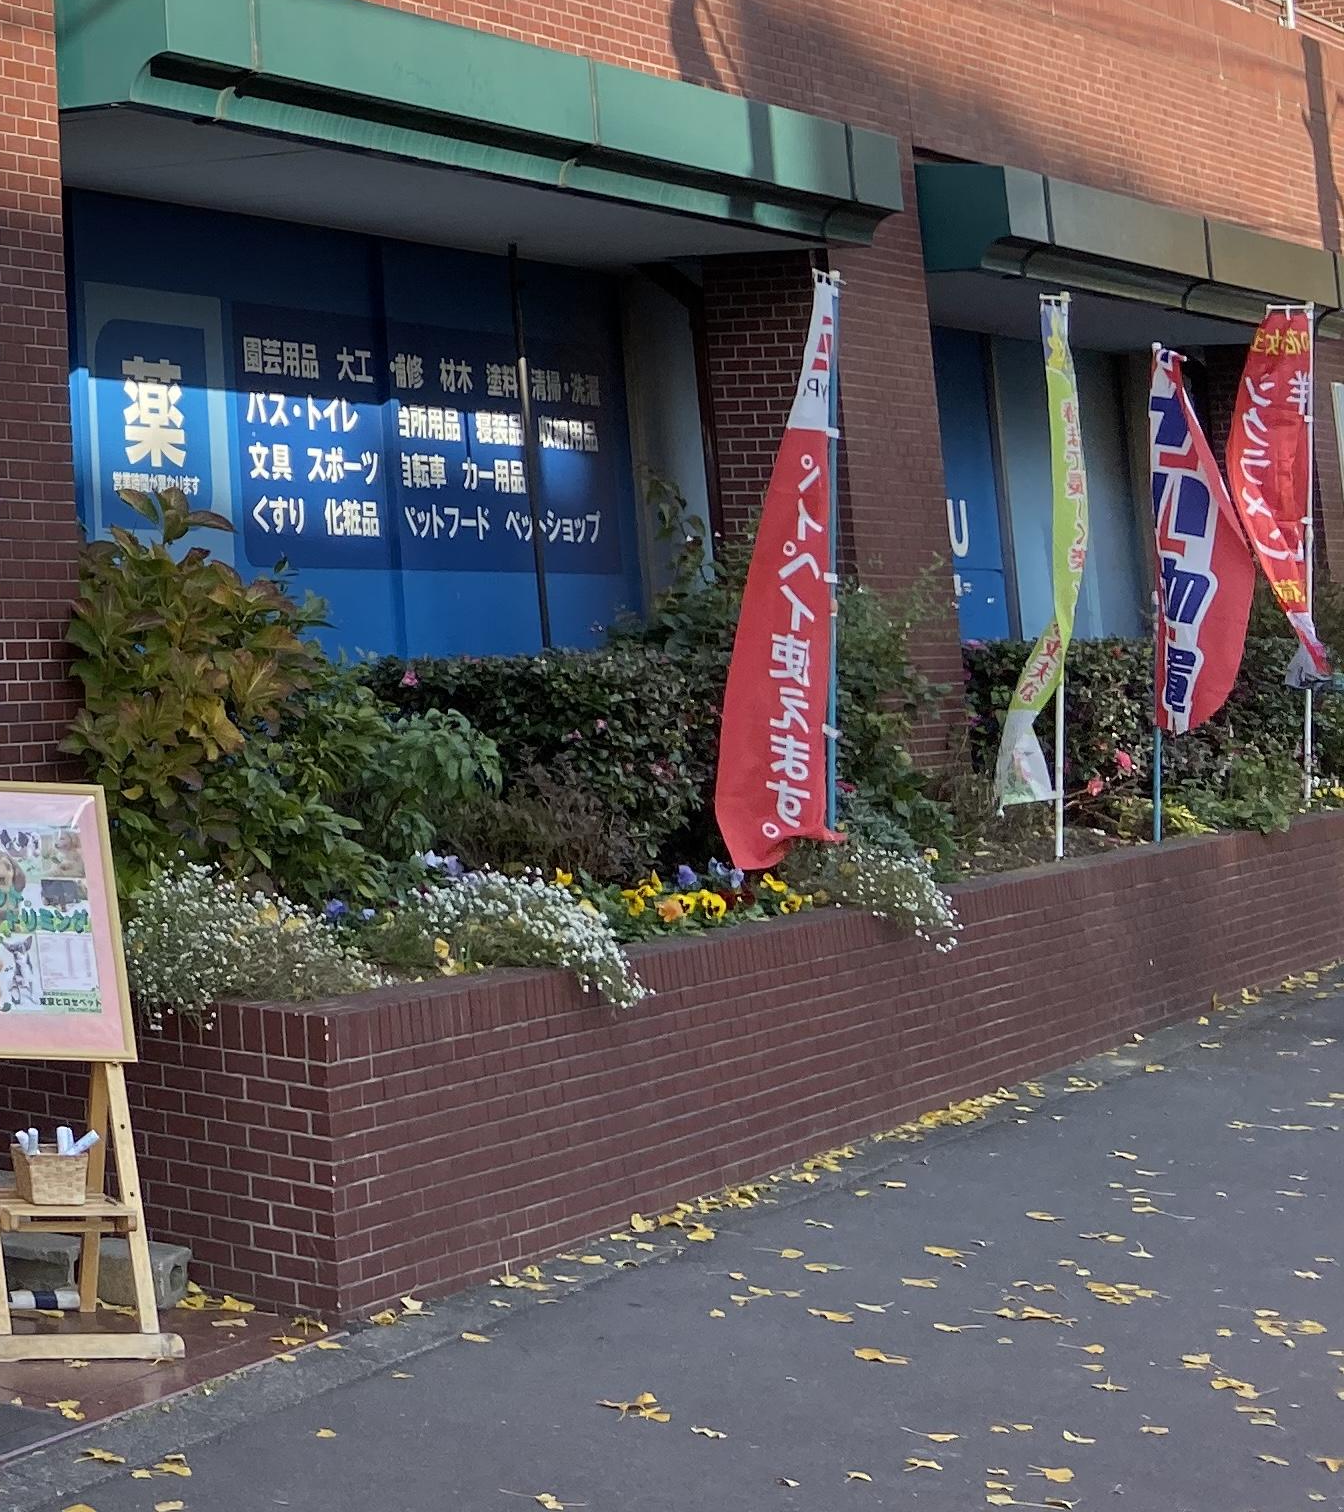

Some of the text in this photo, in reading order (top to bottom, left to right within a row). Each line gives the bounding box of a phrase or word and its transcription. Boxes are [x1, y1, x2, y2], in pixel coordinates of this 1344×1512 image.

[242, 336, 319, 380] 園芸用品
[439, 357, 473, 394] 材木
[486, 362, 519, 399] 塗料
[121, 355, 187, 468] 薬
[246, 391, 359, 433] バス・トイレ
[248, 441, 293, 482] 文具
[307, 446, 379, 485] スポーツ
[462, 456, 527, 495] カー用品
[252, 495, 305, 535] くすり
[324, 497, 381, 537] 化粧品
[404, 503, 490, 541] ペットフード
